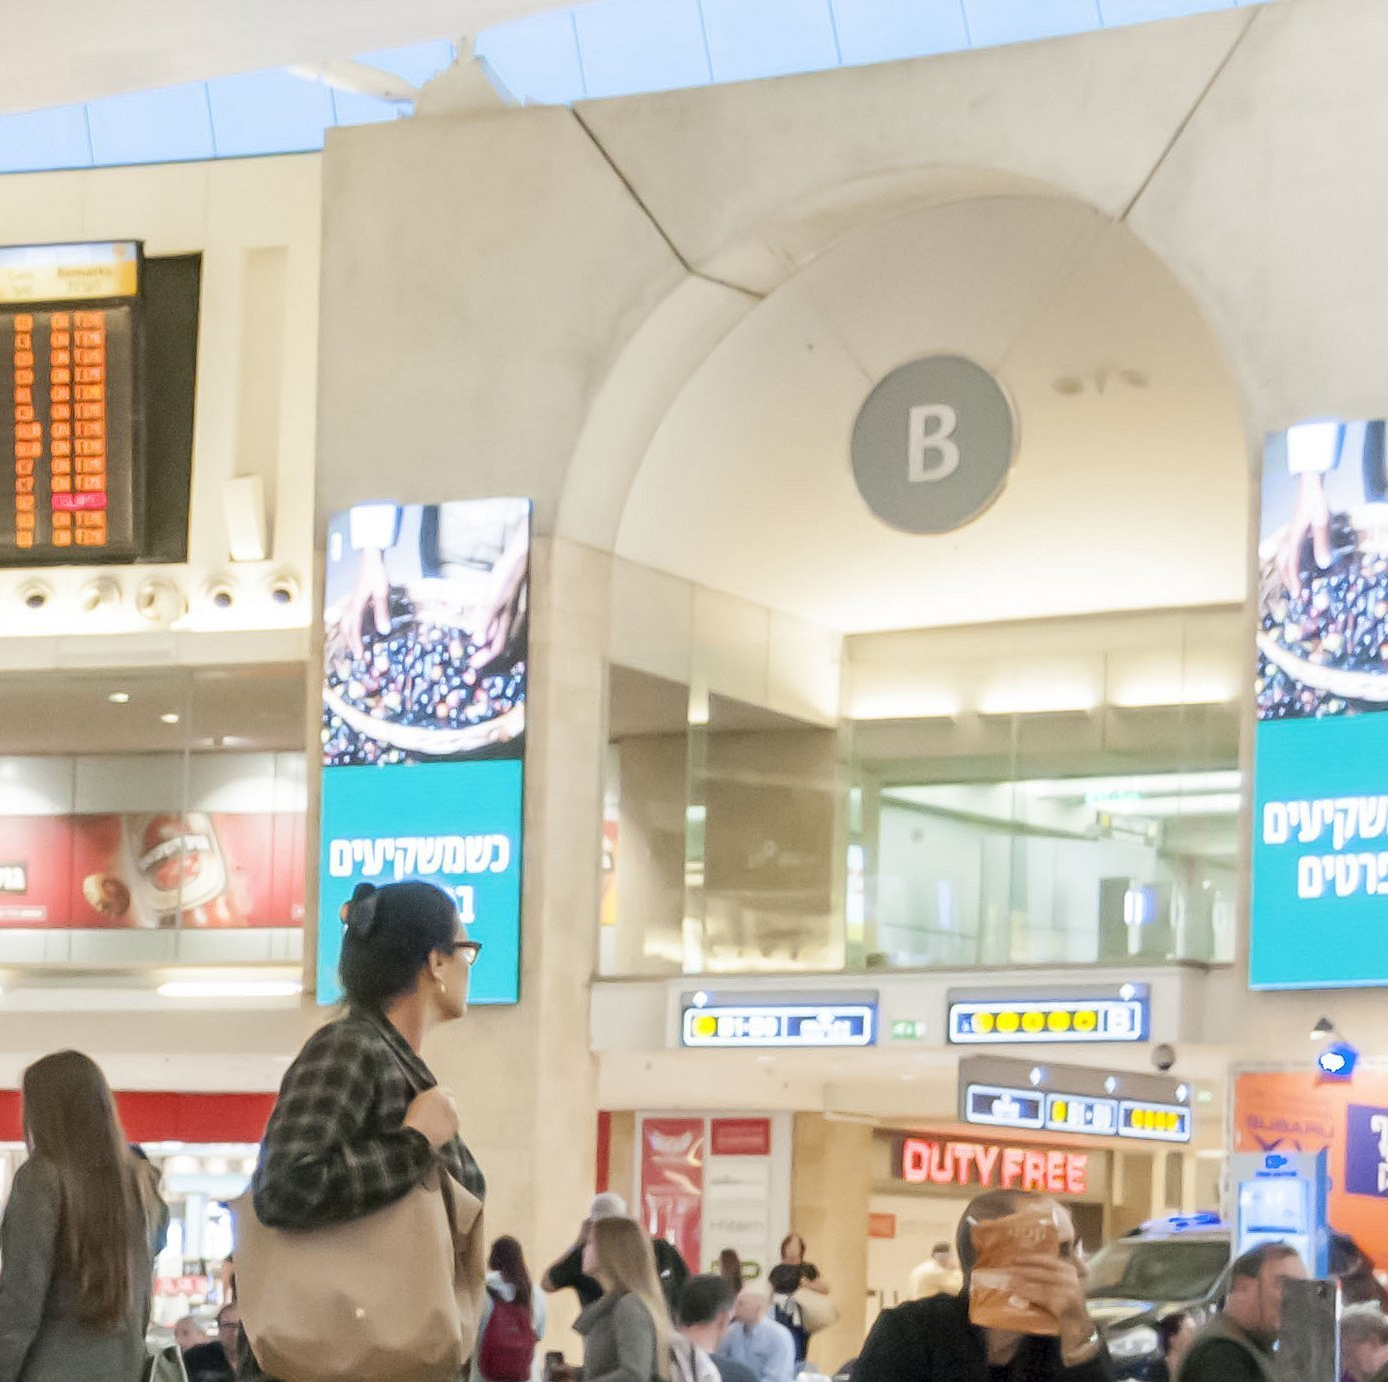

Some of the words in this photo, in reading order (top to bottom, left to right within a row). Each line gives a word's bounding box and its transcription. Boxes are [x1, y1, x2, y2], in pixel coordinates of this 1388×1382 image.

[908, 404, 960, 482] B
[1263, 795, 1388, 850] שקיעים
[329, 834, 510, 881] כשמשקיעים
[1298, 851, 1388, 899] רטים
[902, 1138, 1000, 1188] DUTY
[1001, 1147, 1089, 1195] FREE
